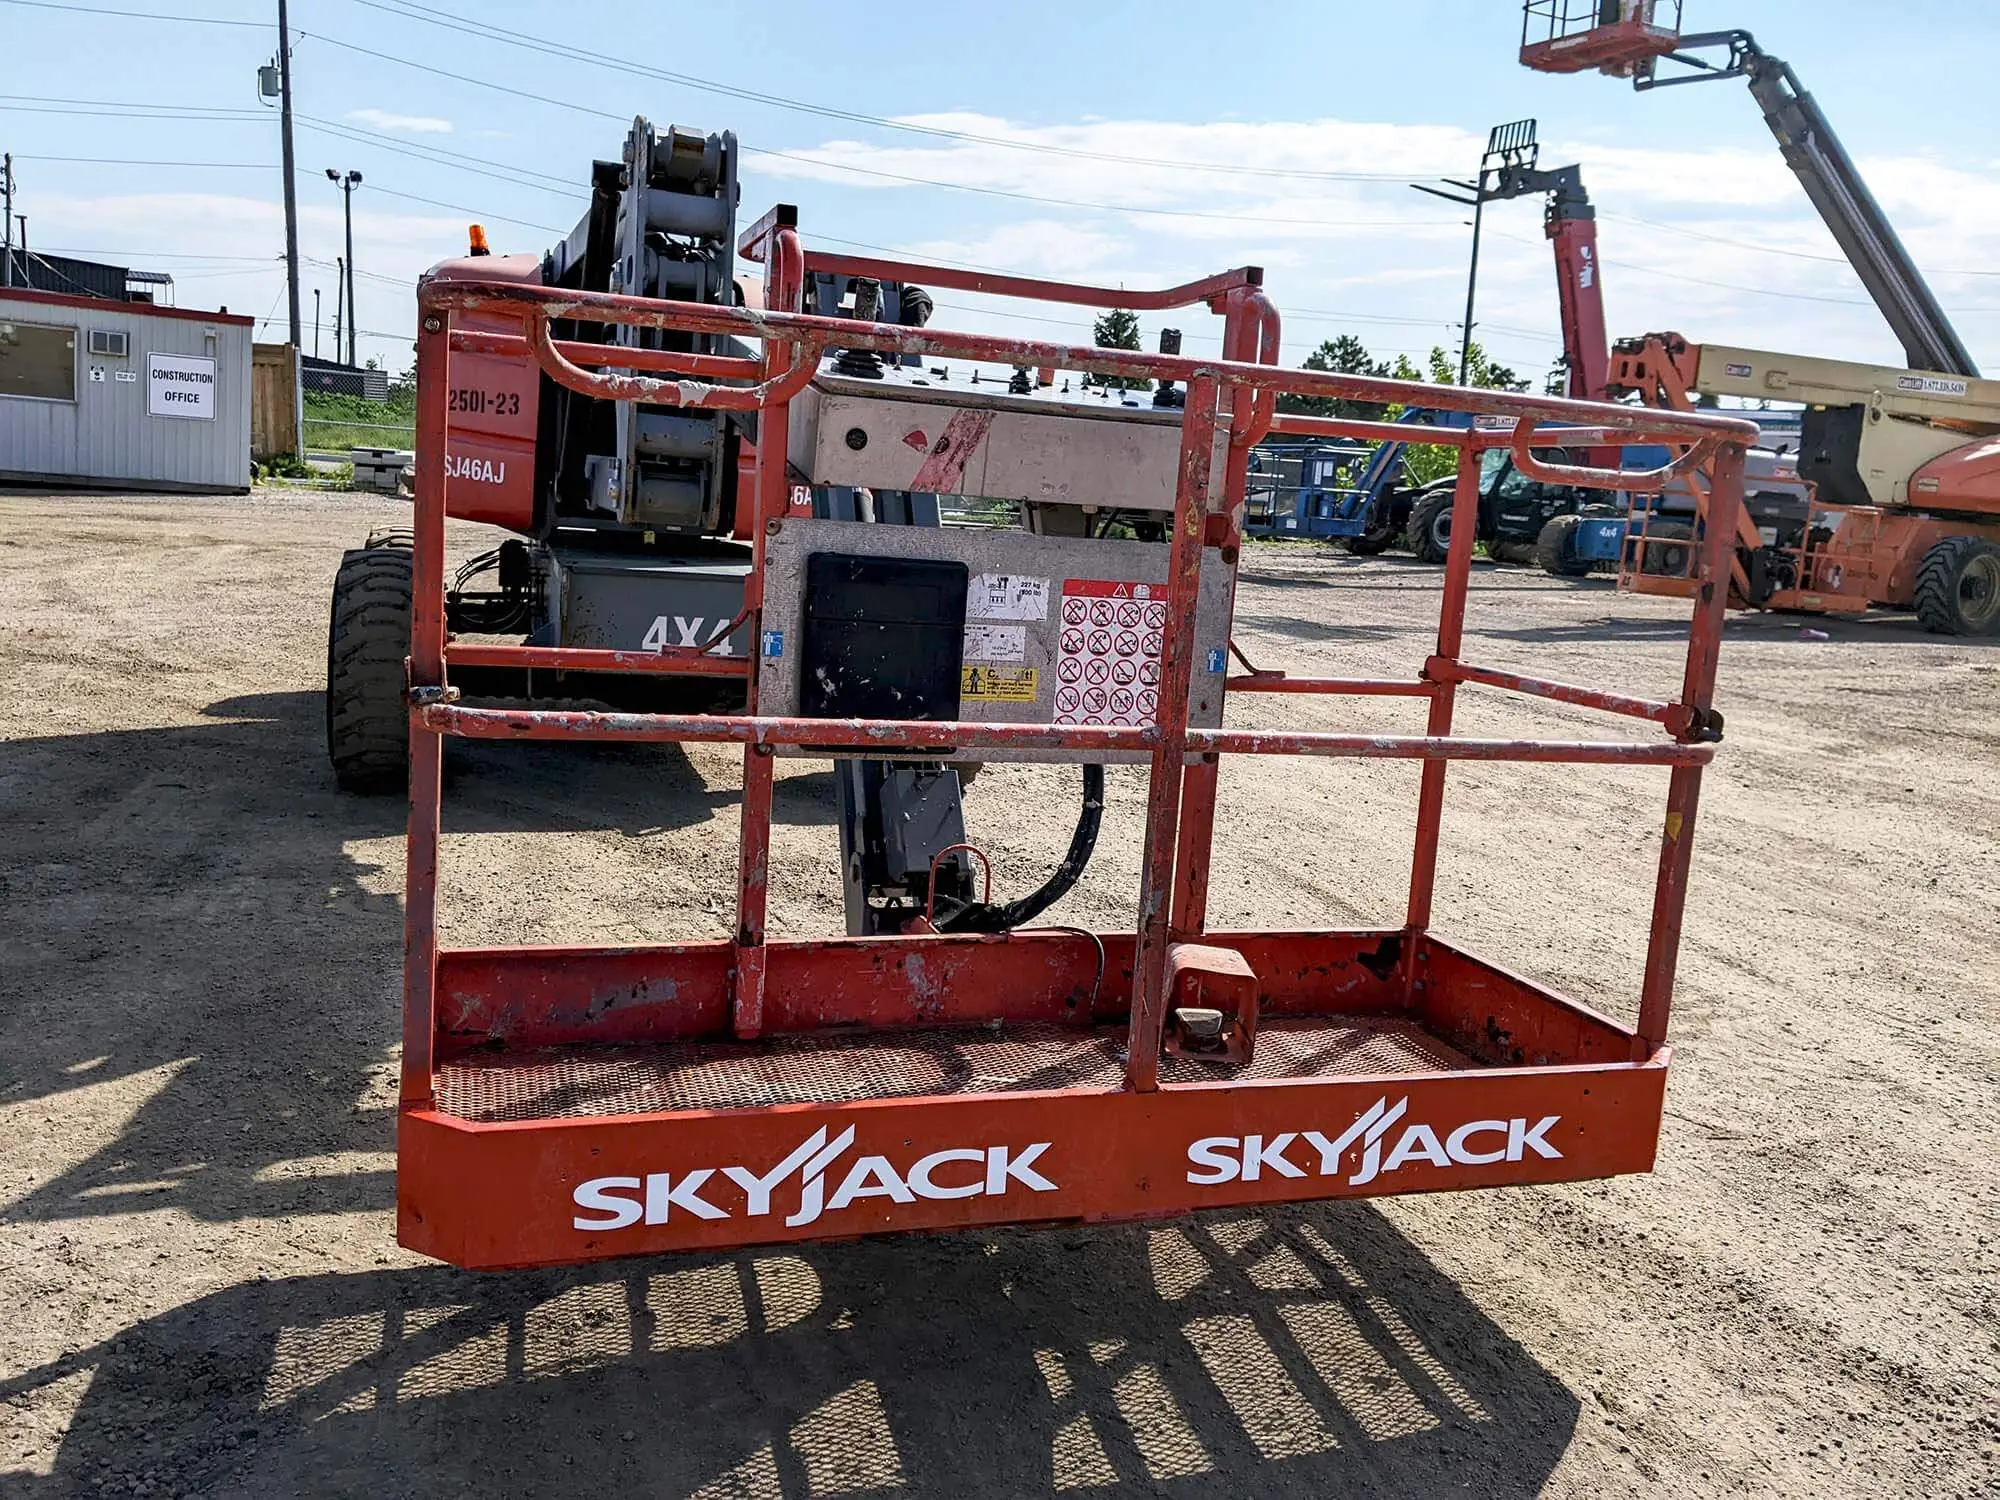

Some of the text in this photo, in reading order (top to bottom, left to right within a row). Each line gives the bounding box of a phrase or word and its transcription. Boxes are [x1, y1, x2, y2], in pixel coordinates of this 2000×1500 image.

[152, 368, 213, 384] CONSTRUCTION
[165, 391, 201, 403] OFFICE
[445, 455, 505, 485] SJ46AJ
[1599, 527, 1617, 538] 4x4
[1033, 581, 1041, 590] kg
[642, 616, 733, 656] 4X4
[1186, 1095, 1563, 1186] SKYJACK
[571, 1124, 1058, 1230] SKYJACK
